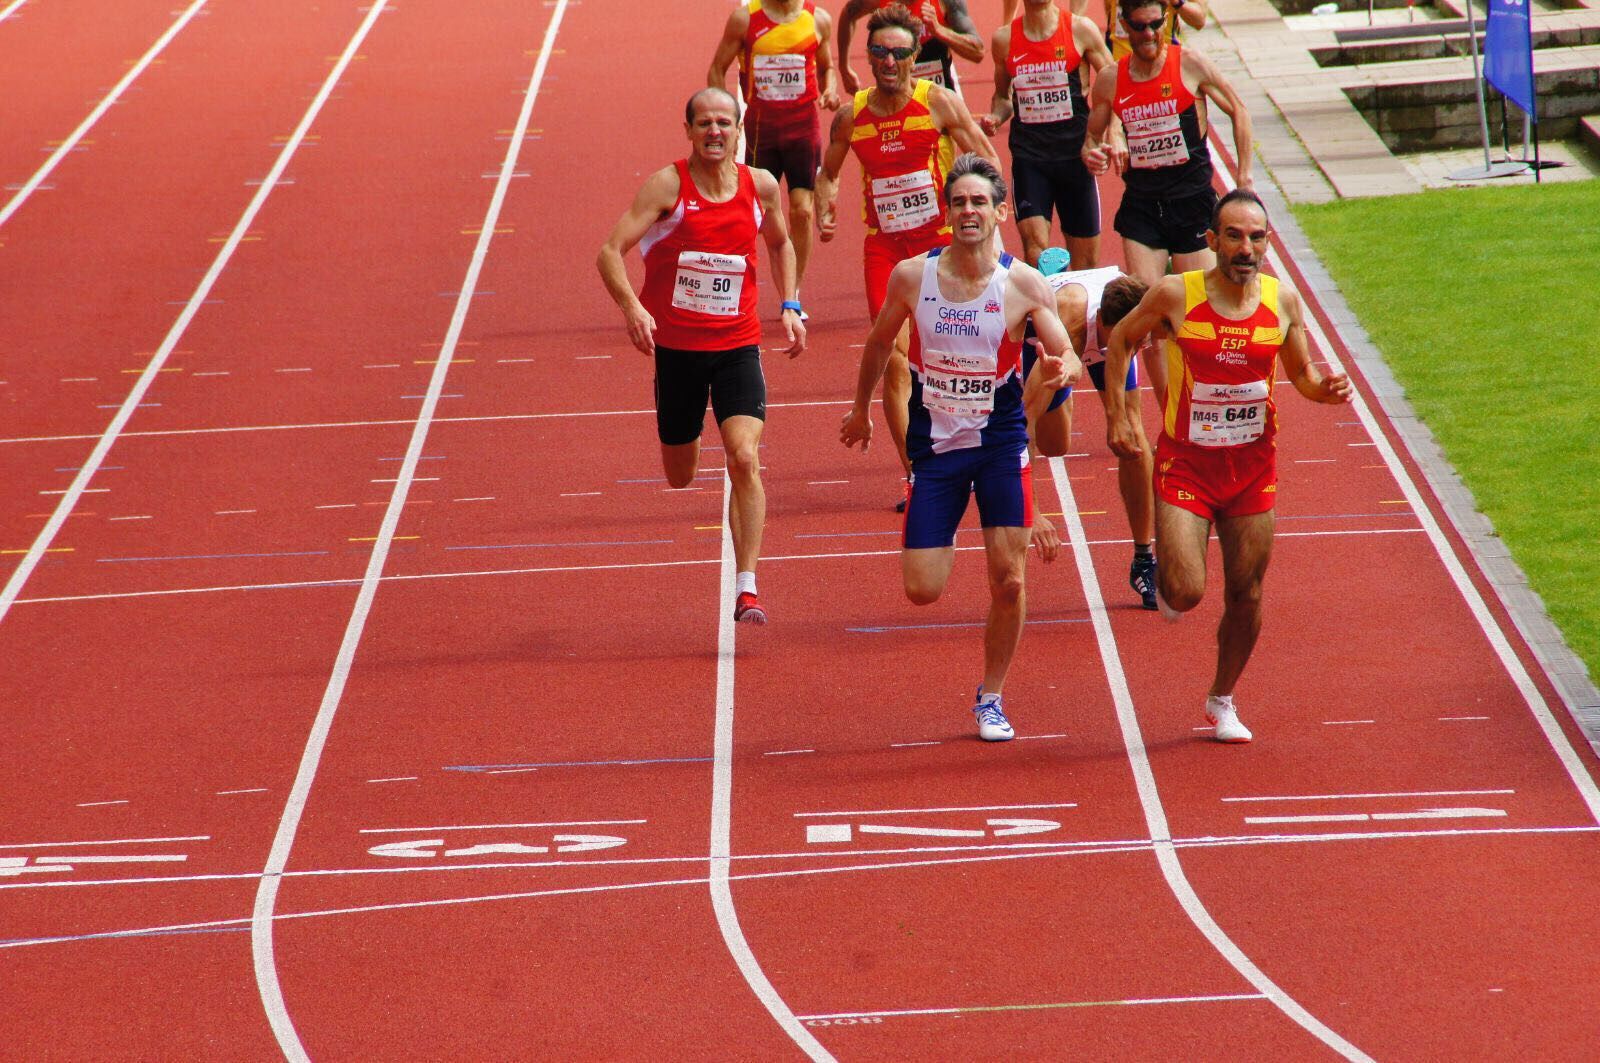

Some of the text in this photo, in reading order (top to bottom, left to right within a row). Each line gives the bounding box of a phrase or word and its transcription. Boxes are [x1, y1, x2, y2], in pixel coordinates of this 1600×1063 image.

[1016, 60, 1066, 75] GERMANY
[778, 72, 799, 83] 704
[1020, 90, 1068, 105] M45 1858
[1122, 99, 1177, 122] GERMANY
[882, 130, 900, 141] ESP
[1130, 145, 1147, 155] M45
[1148, 135, 1182, 152] 2232
[877, 202, 897, 213] M45
[902, 192, 929, 208] 835
[678, 276, 731, 293] M45 50
[939, 307, 979, 321] GREAT
[935, 322, 980, 336] BRITAIN
[1218, 326, 1250, 335] Joma
[1221, 338, 1247, 350] ESP
[926, 376, 992, 394] M45 1358
[1193, 406, 1257, 422] M45 648
